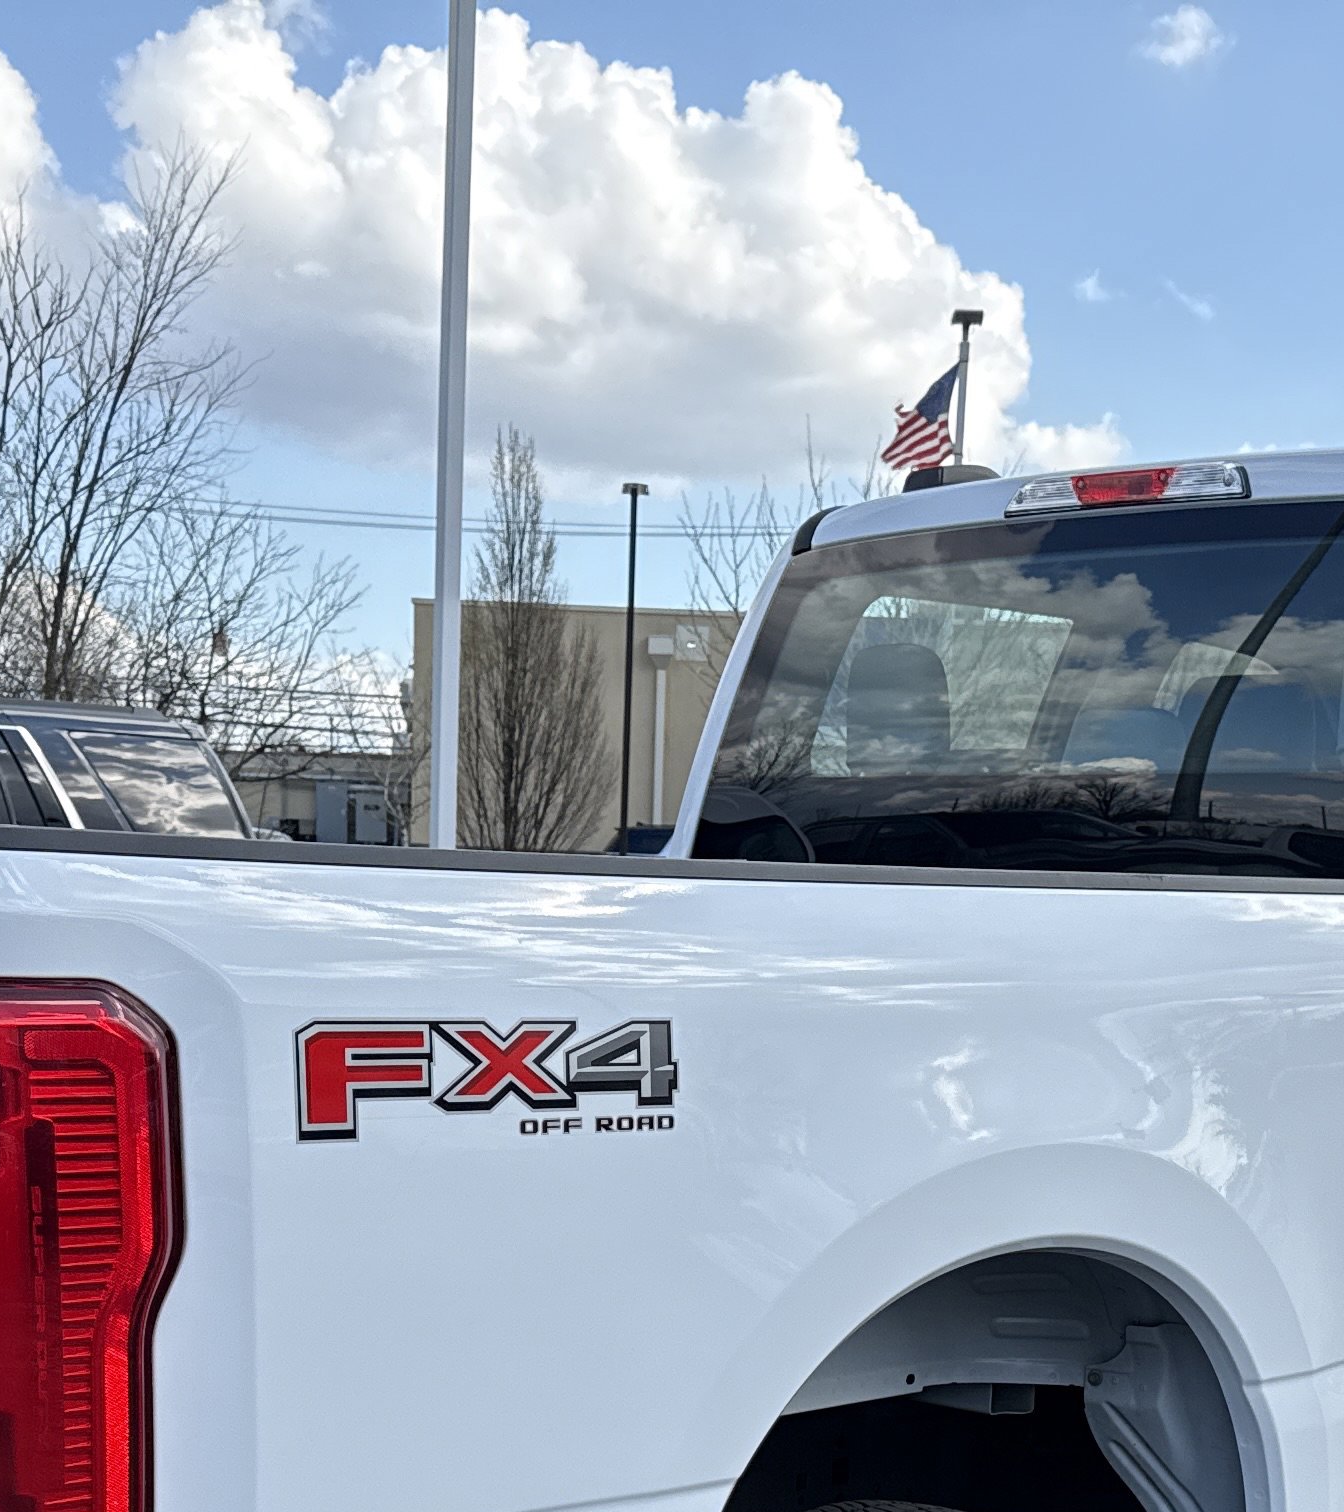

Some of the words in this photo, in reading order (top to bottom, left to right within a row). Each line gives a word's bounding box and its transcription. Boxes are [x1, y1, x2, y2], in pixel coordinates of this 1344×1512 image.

[293, 1017, 679, 1144] FX4
[519, 1116, 582, 1136] OFF
[594, 1114, 676, 1134] ROAD
